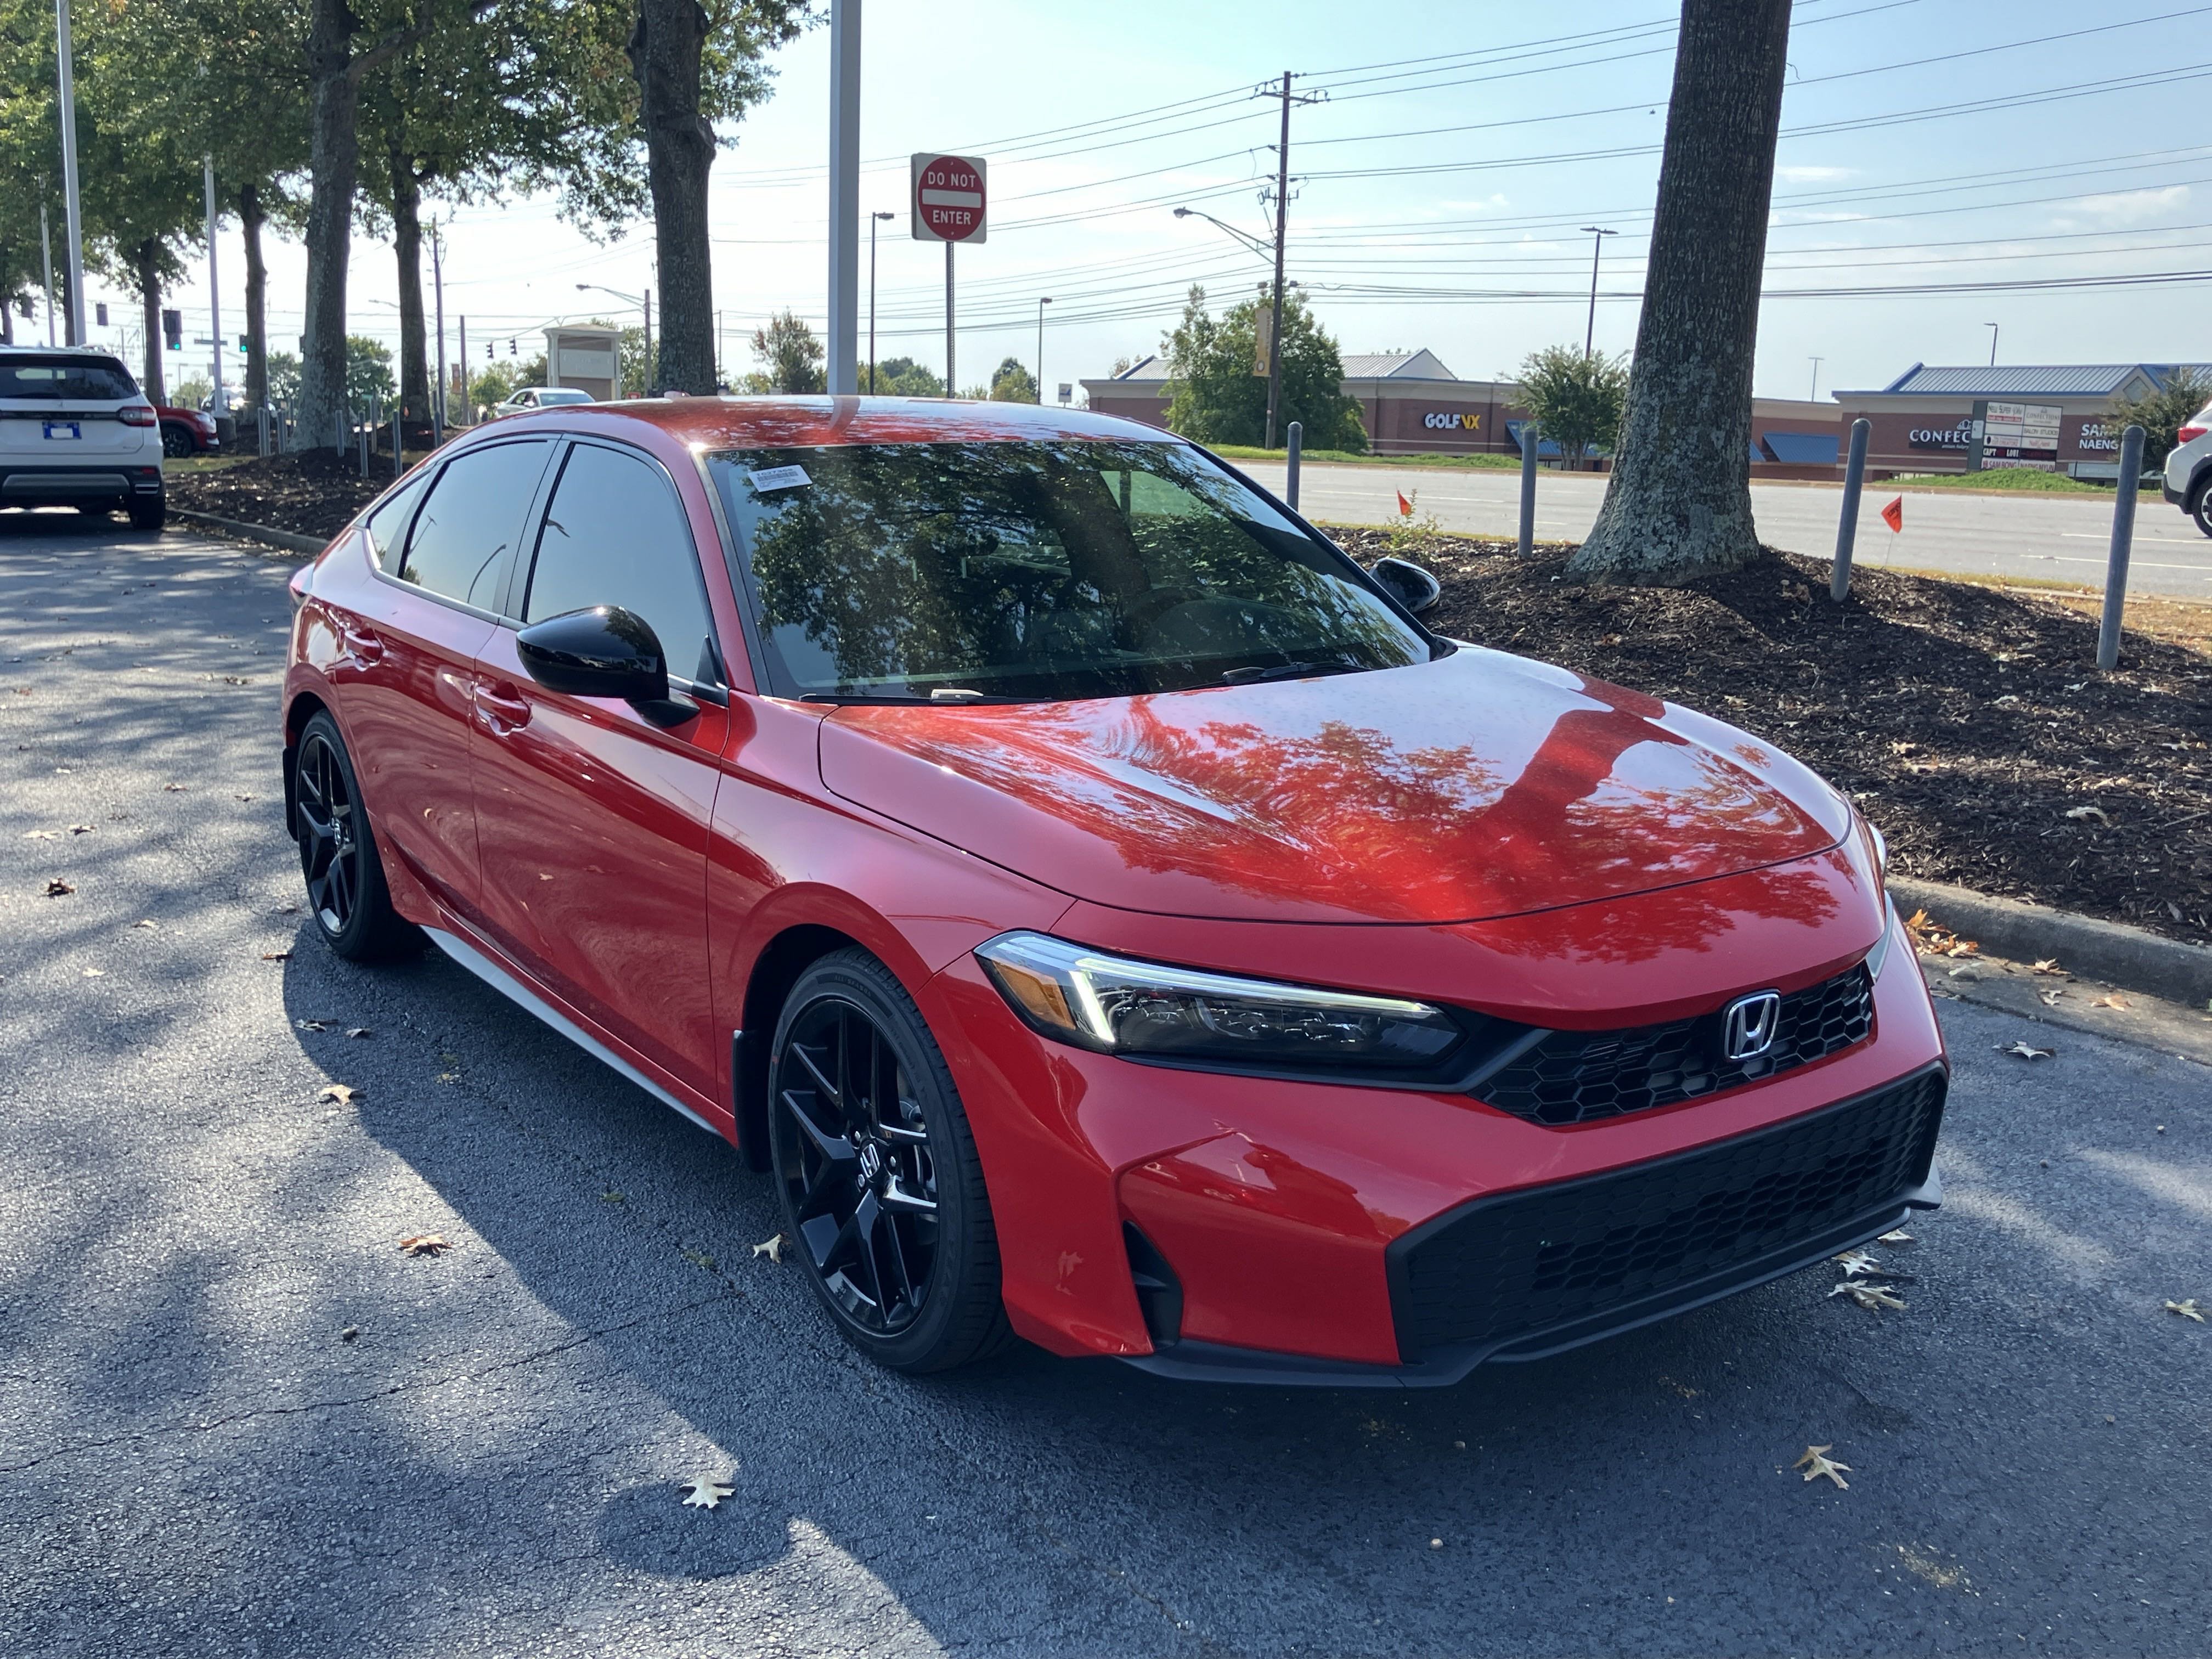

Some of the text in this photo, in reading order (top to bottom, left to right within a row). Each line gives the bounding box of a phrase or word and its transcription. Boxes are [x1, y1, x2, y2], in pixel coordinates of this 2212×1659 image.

[928, 171, 976, 188] DO NOT
[933, 210, 971, 225] ENTER
[2079, 438, 2119, 450] NAENG
